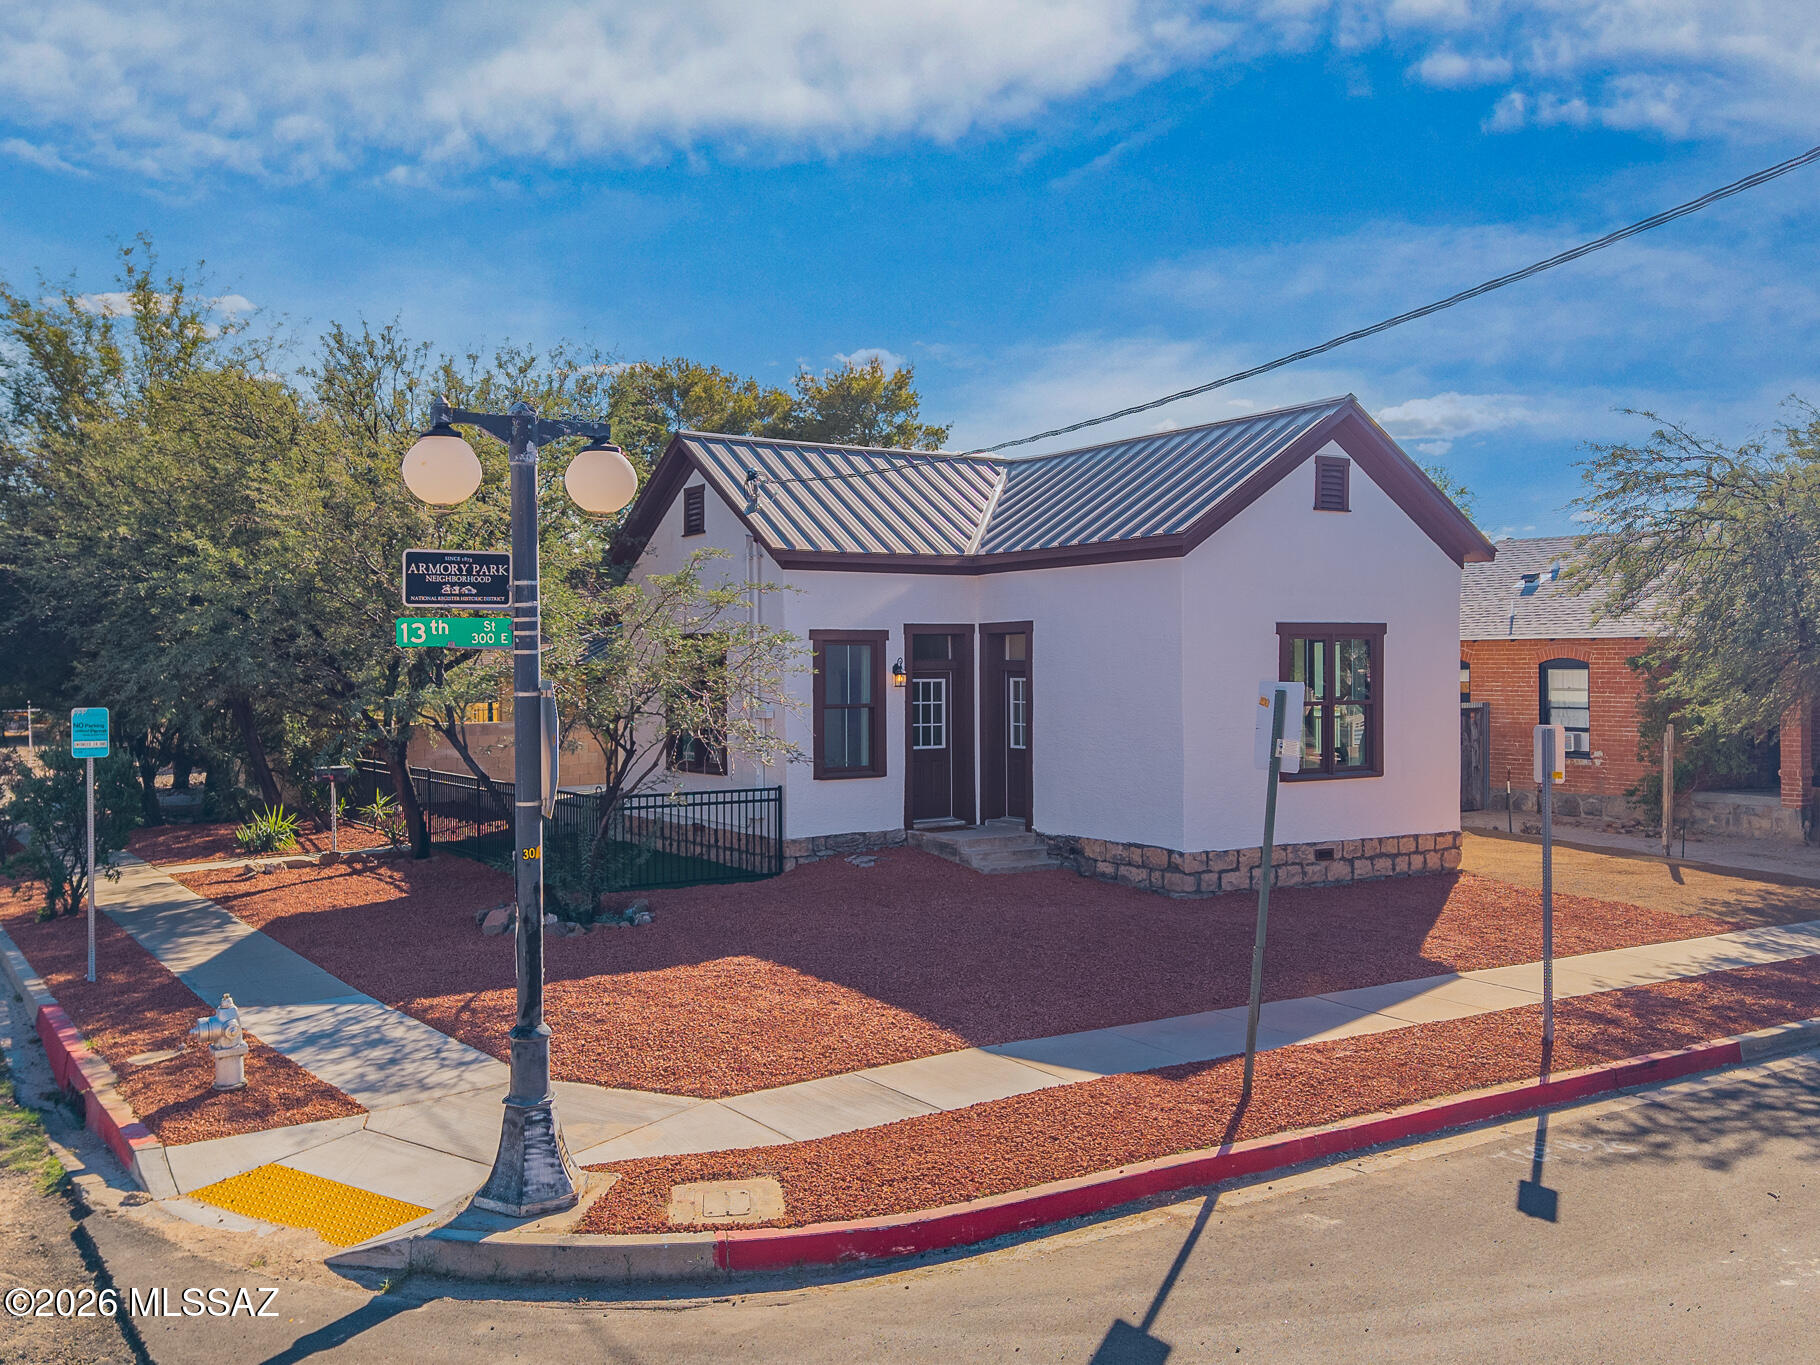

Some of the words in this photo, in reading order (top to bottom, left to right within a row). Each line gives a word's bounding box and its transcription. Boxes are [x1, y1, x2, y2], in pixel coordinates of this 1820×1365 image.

[407, 563, 470, 575] ARMORY
[472, 564, 508, 576] PARK
[425, 575, 492, 583] NEIGHBORHOOD
[401, 620, 449, 643] 13th
[483, 621, 496, 632] St
[471, 633, 495, 644] 300
[501, 633, 508, 643] E
